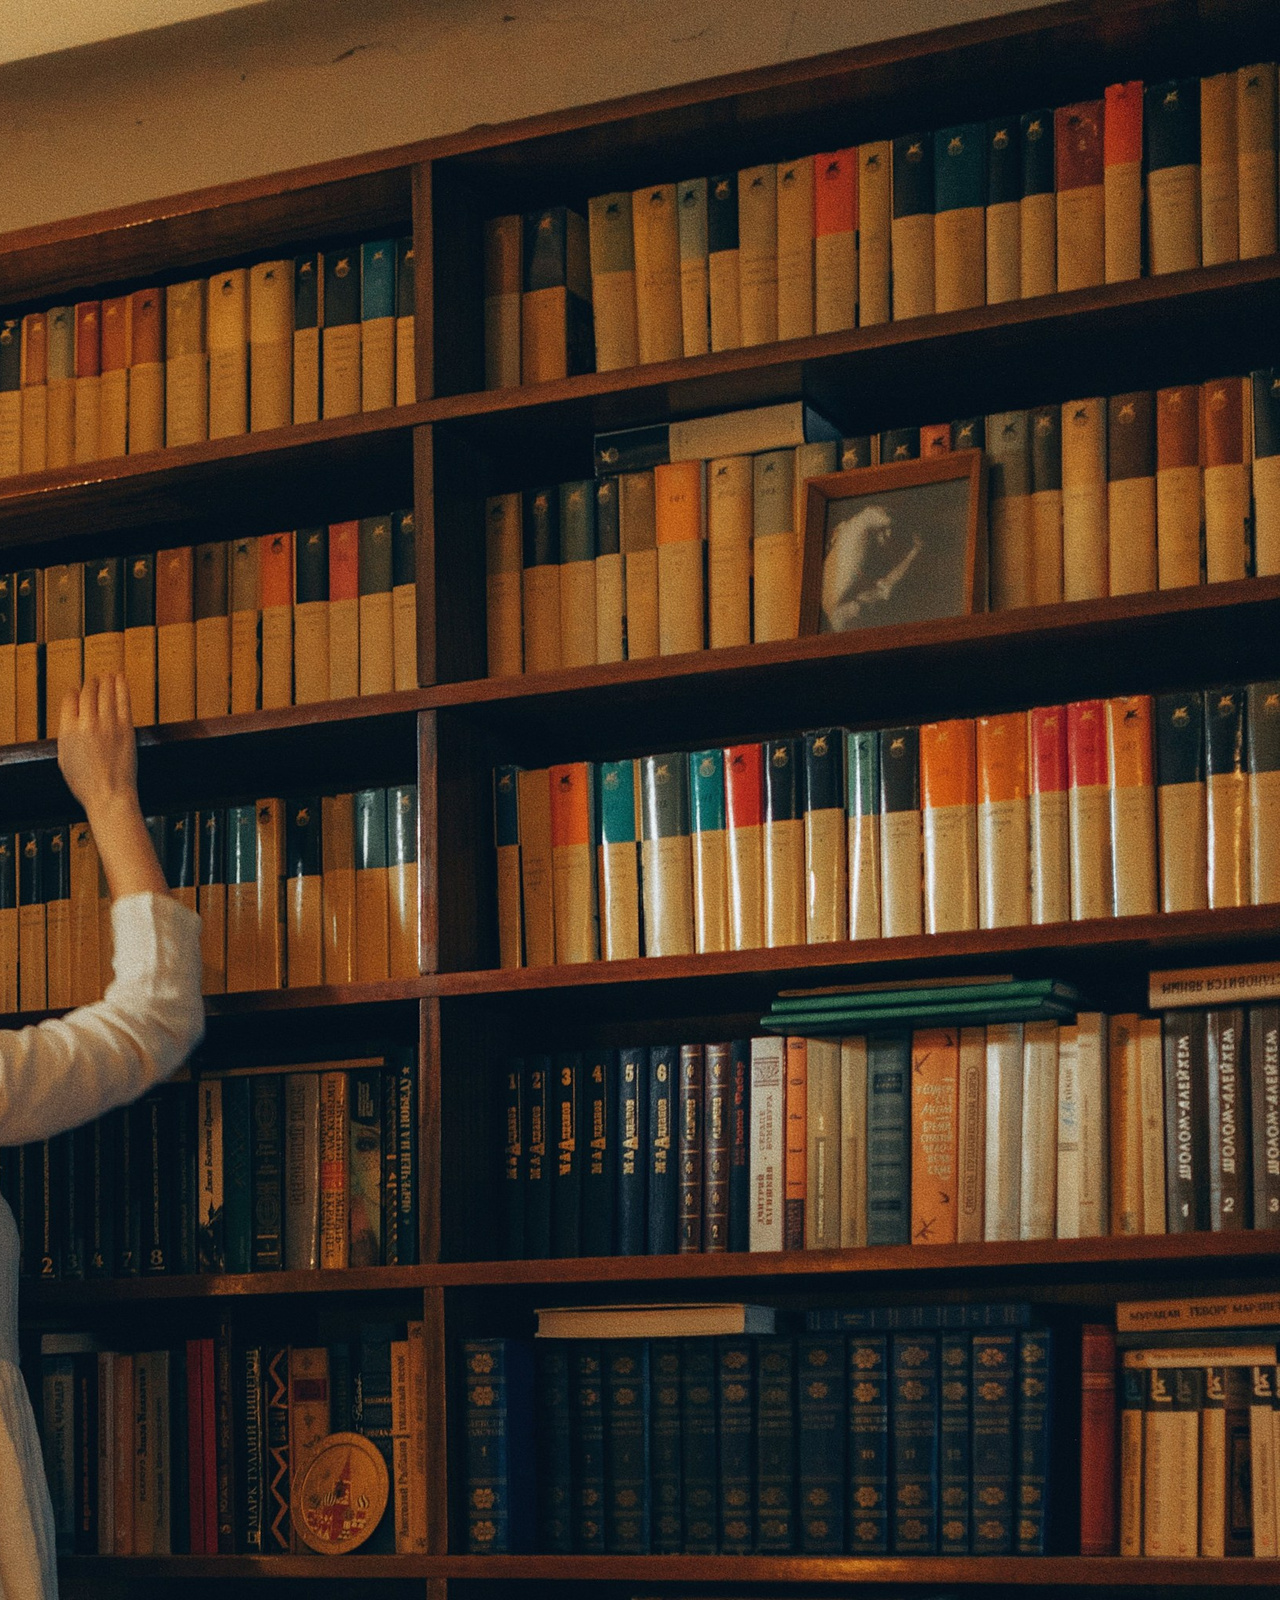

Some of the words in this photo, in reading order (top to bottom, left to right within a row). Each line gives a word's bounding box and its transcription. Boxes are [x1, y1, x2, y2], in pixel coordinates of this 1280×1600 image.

[508, 1072, 517, 1090] 1
[532, 1071, 542, 1090] 2
[561, 1067, 572, 1086] 3
[592, 1064, 603, 1084] 4
[624, 1063, 635, 1083] 5
[656, 1063, 668, 1083] 6
[400, 1076, 412, 1128] ПОБЕДУ
[1177, 1035, 1193, 1181] ШОЛОМ-АЛЕЙХЕМ
[1219, 1027, 1236, 1174] ШОЛОМ-АЛЕЙХЕМ
[1264, 1029, 1280, 1175] ШОЛОМ-АЛЕЙХЕМ
[401, 1129, 412, 1150] НА
[401, 1152, 412, 1214] ОБРЕЧЕН
[1180, 1202, 1190, 1218] 1
[1223, 1197, 1235, 1213] 2
[1268, 1197, 1280, 1214] 3
[41, 1256, 54, 1274] 2
[67, 1253, 78, 1269] 3
[91, 1251, 104, 1269] 4
[122, 1250, 133, 1267] 7
[149, 1248, 164, 1265] 8
[244, 1349, 260, 1421] ЦИЦЕРОН
[246, 1424, 258, 1482] ТУЛЛИЙ
[247, 1485, 258, 1527] МАРК
